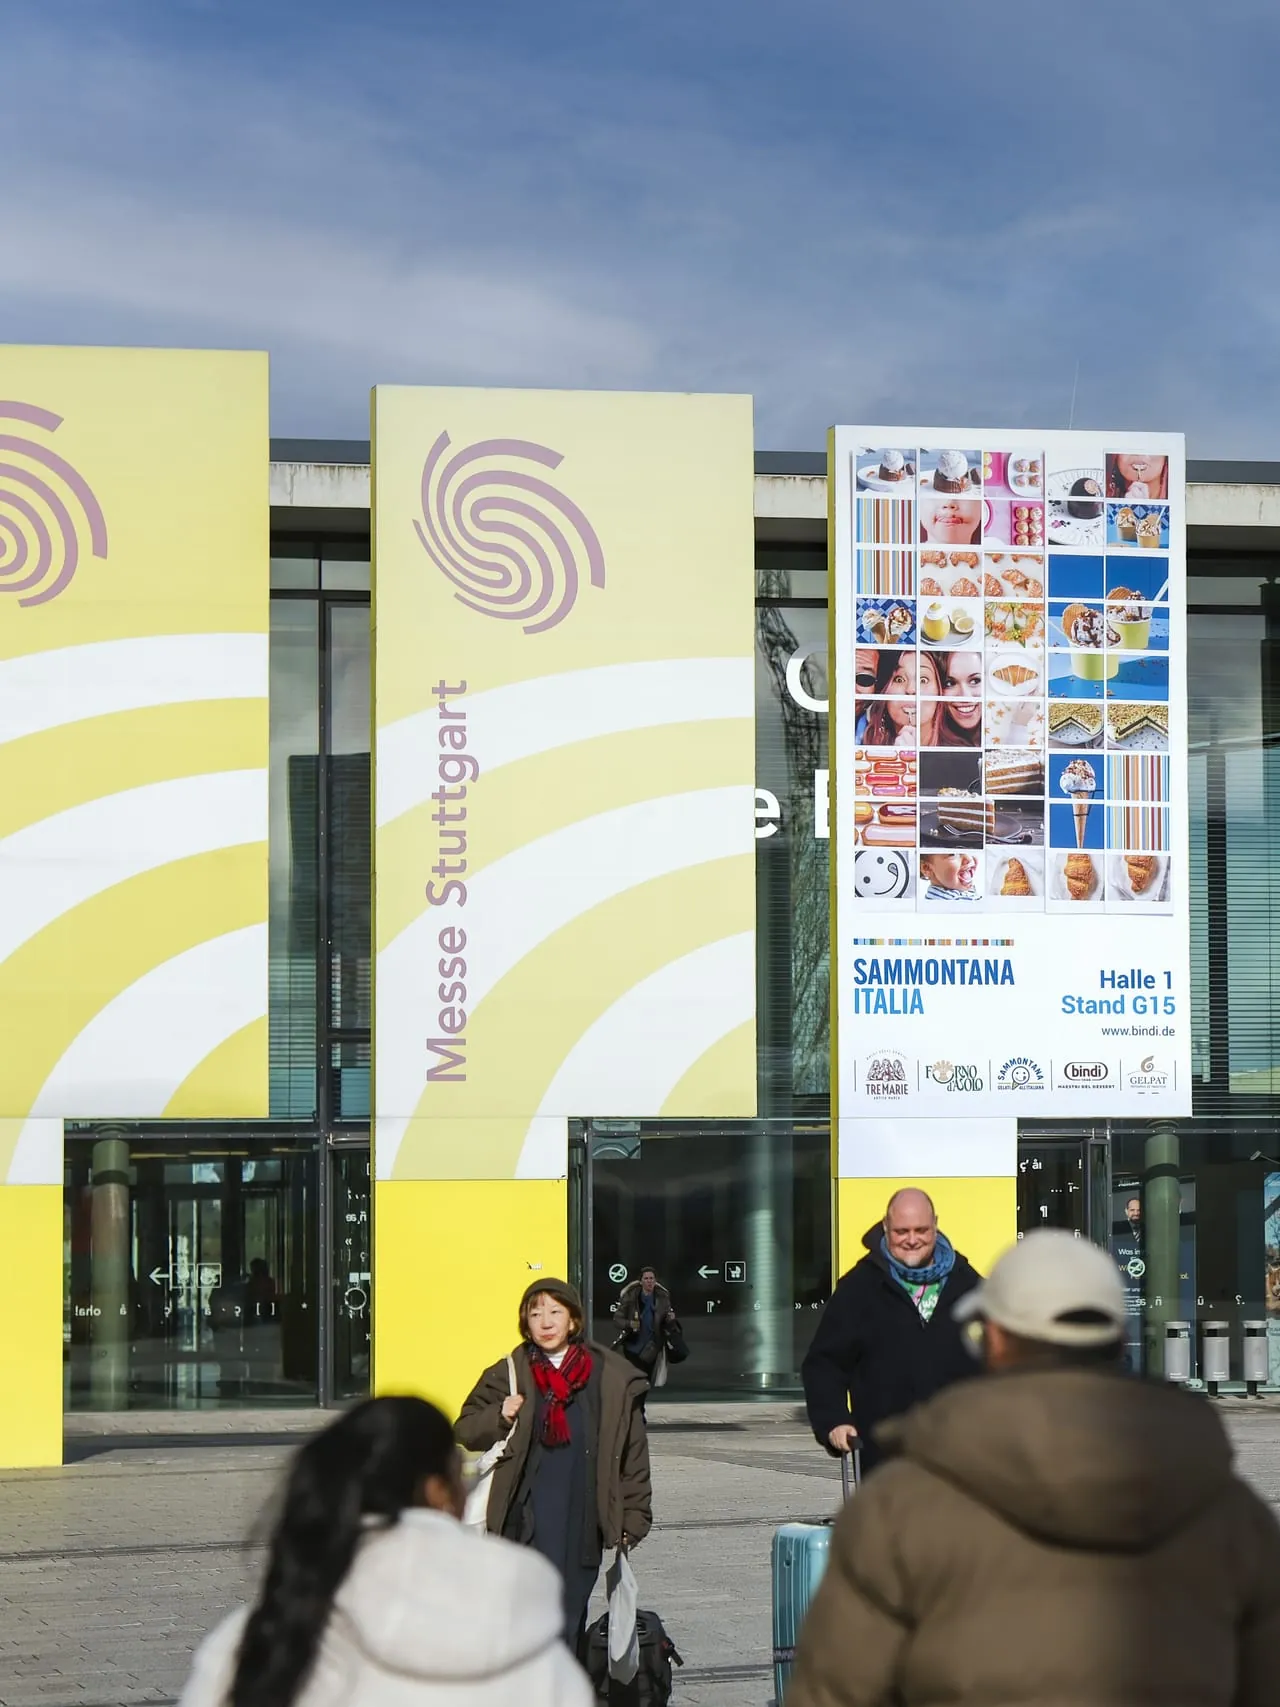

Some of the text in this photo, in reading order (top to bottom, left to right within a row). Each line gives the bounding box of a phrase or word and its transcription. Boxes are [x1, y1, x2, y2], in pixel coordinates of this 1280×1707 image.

[426, 679, 480, 1082] Messe Stuttgart
[853, 958, 1015, 986] SAMMONTANA
[1099, 969, 1173, 990] Halle 1
[854, 988, 925, 1015] ITALIA
[1061, 995, 1177, 1016] Stand G15
[1101, 1025, 1176, 1038] www.bindi.de
[997, 1057, 1044, 1081] SAMMONTANA
[1071, 1064, 1102, 1078] bindi
[1129, 1076, 1168, 1085] GELPAT
